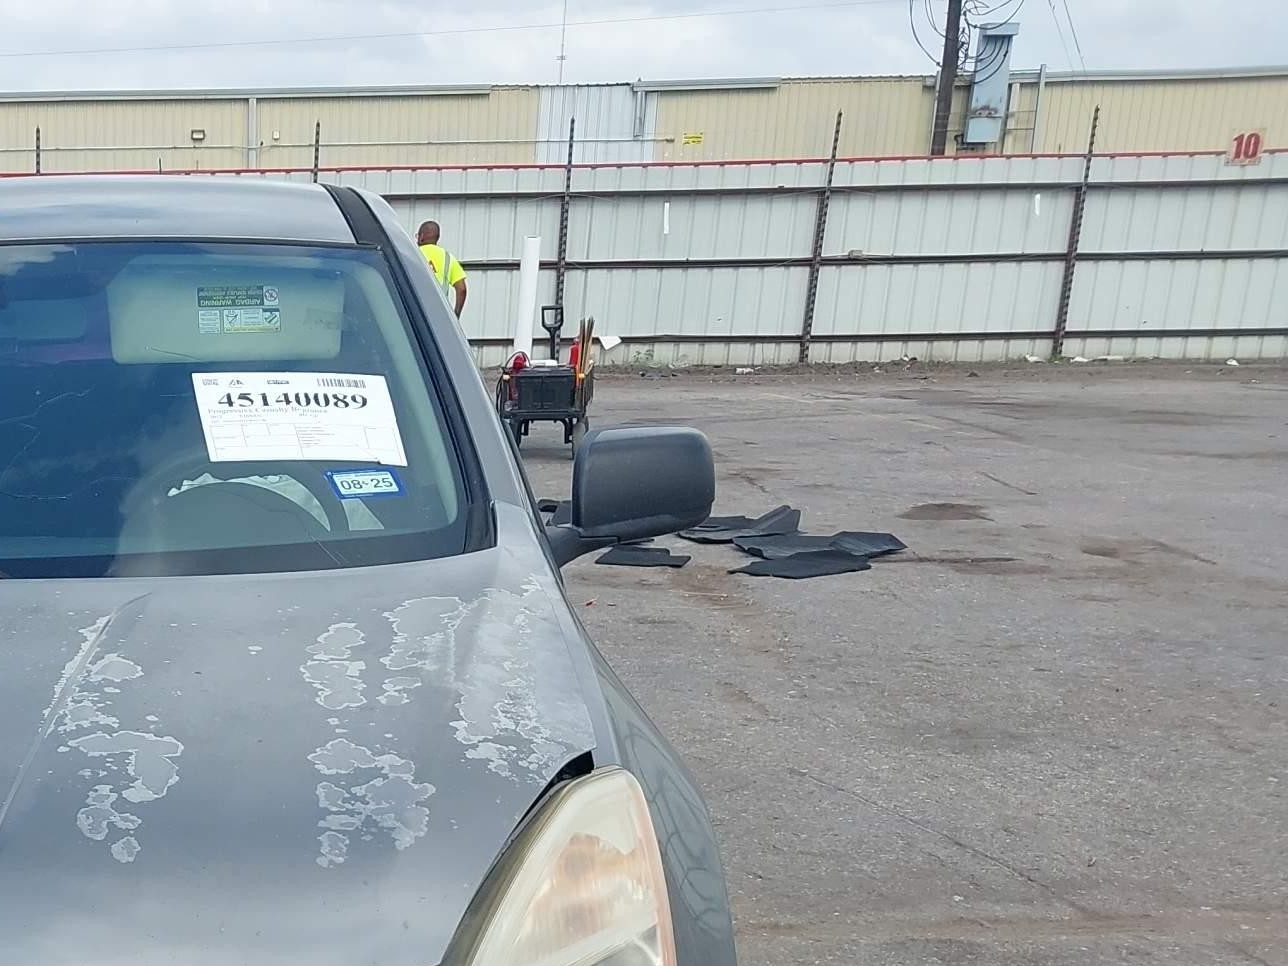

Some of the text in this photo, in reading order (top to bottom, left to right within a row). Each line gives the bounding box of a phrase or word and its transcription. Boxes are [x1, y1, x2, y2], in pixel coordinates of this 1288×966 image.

[1232, 133, 1261, 160] 10
[217, 391, 368, 410] 45140089
[340, 477, 394, 491] 08 25
